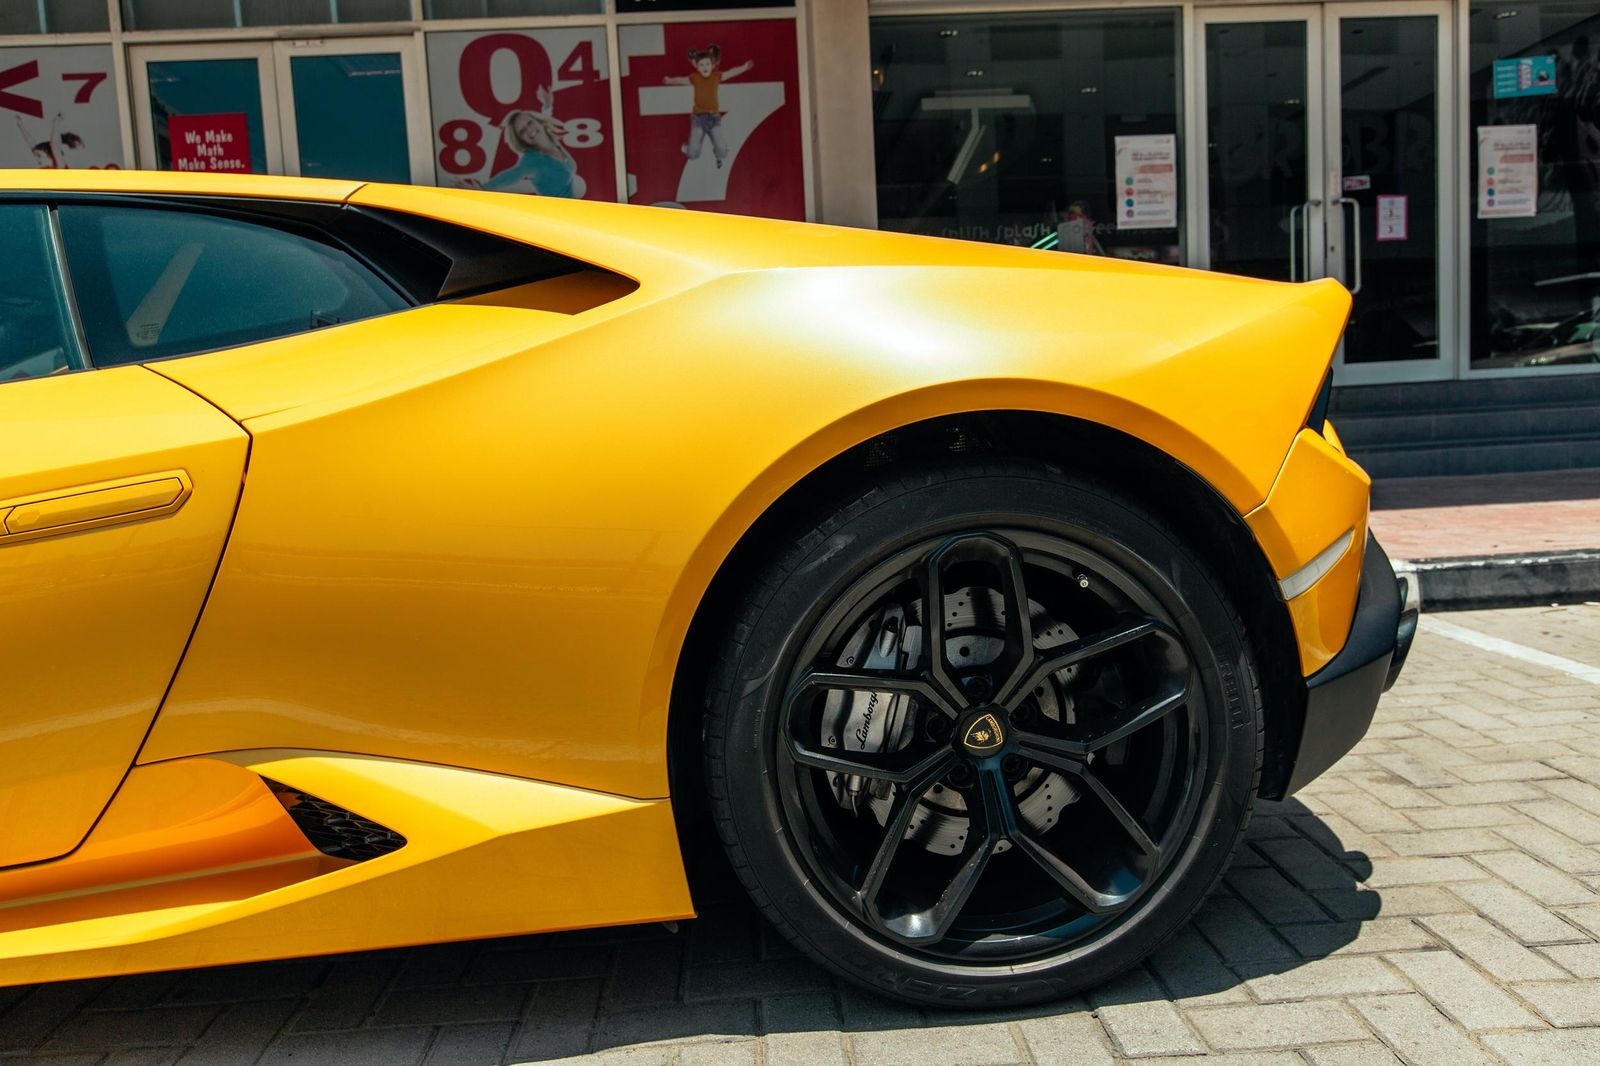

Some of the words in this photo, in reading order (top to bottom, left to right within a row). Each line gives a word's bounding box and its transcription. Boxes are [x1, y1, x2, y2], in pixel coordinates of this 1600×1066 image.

[62, 72, 107, 104] 7
[184, 130, 202, 144] We
[205, 129, 233, 144] Make
[439, 119, 487, 175] 8
[638, 81, 786, 202] 7
[196, 143, 224, 158] Math
[178, 157, 206, 171] Make
[209, 156, 246, 170] Sense.
